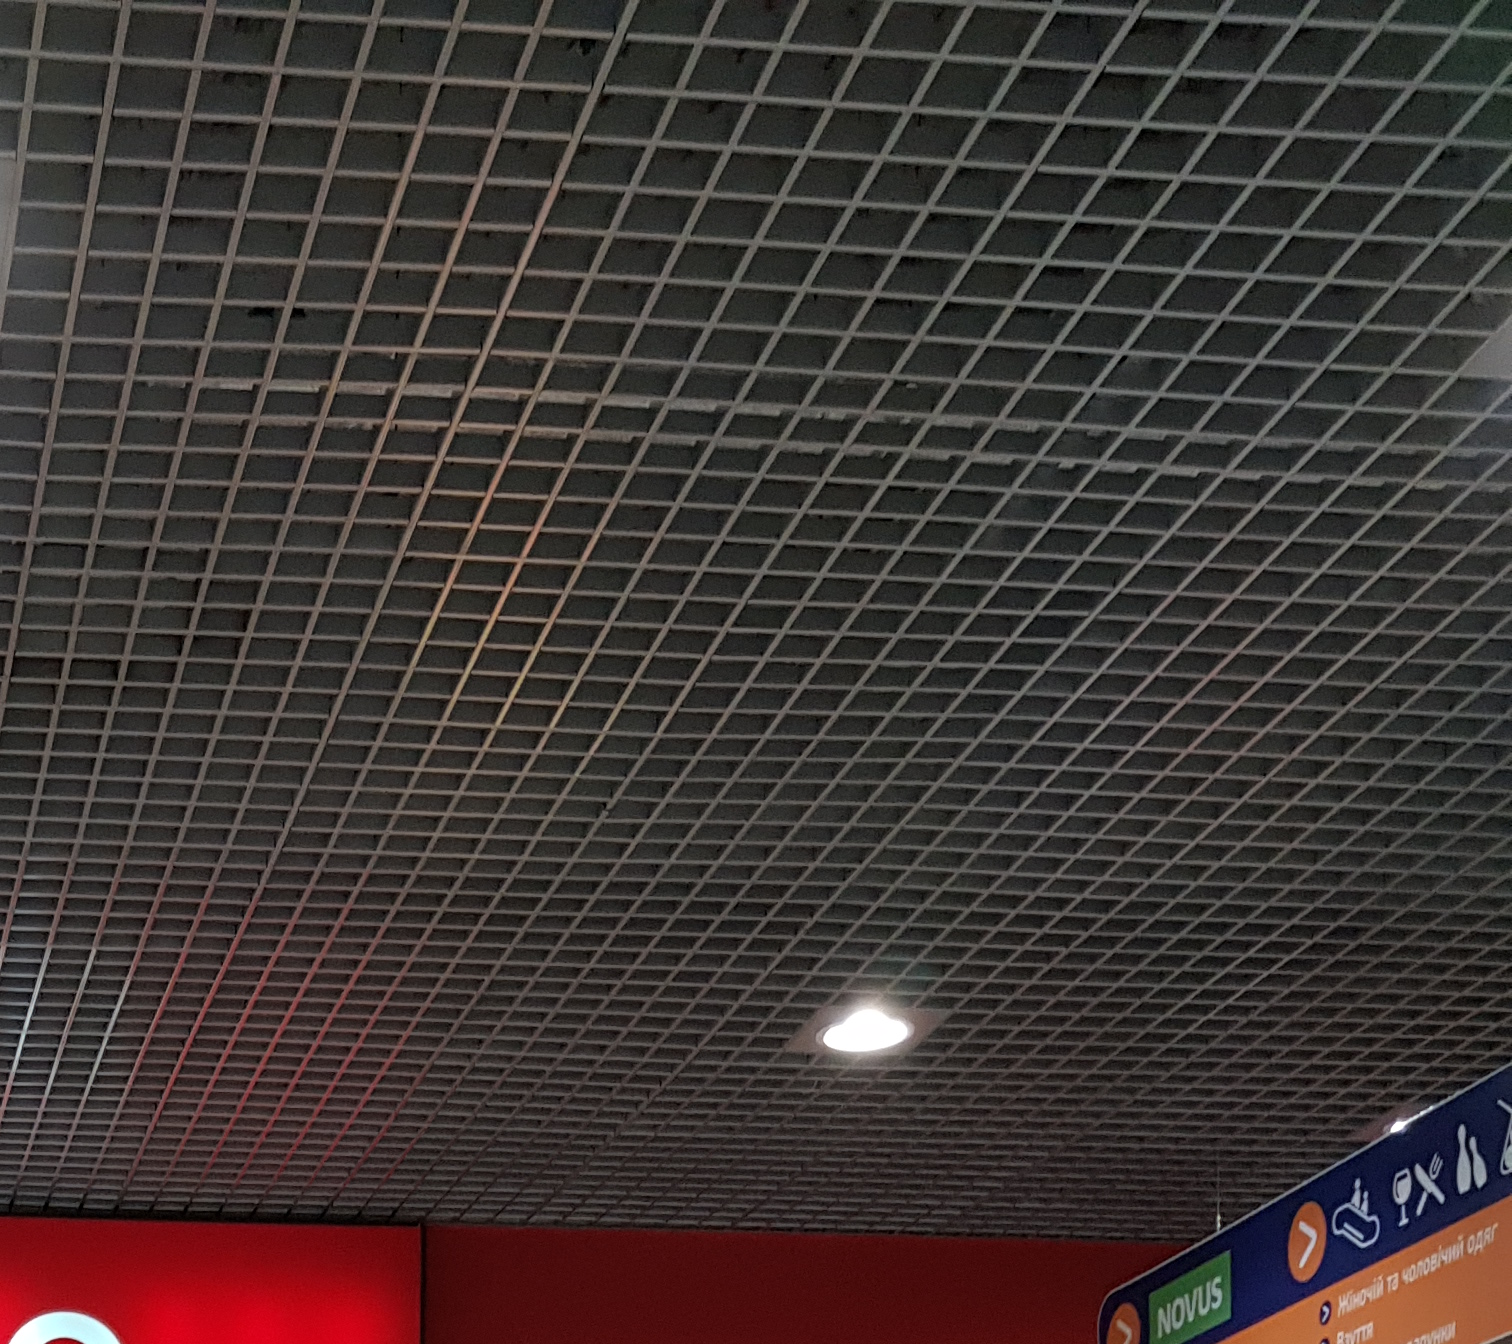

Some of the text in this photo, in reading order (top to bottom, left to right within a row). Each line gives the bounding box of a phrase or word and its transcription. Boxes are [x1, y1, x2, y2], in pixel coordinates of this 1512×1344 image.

[1387, 1271, 1399, 1293] та
[1402, 1234, 1464, 1285] чоловічий
[1467, 1222, 1499, 1256] одяг
[1157, 1276, 1223, 1338] NOVUS
